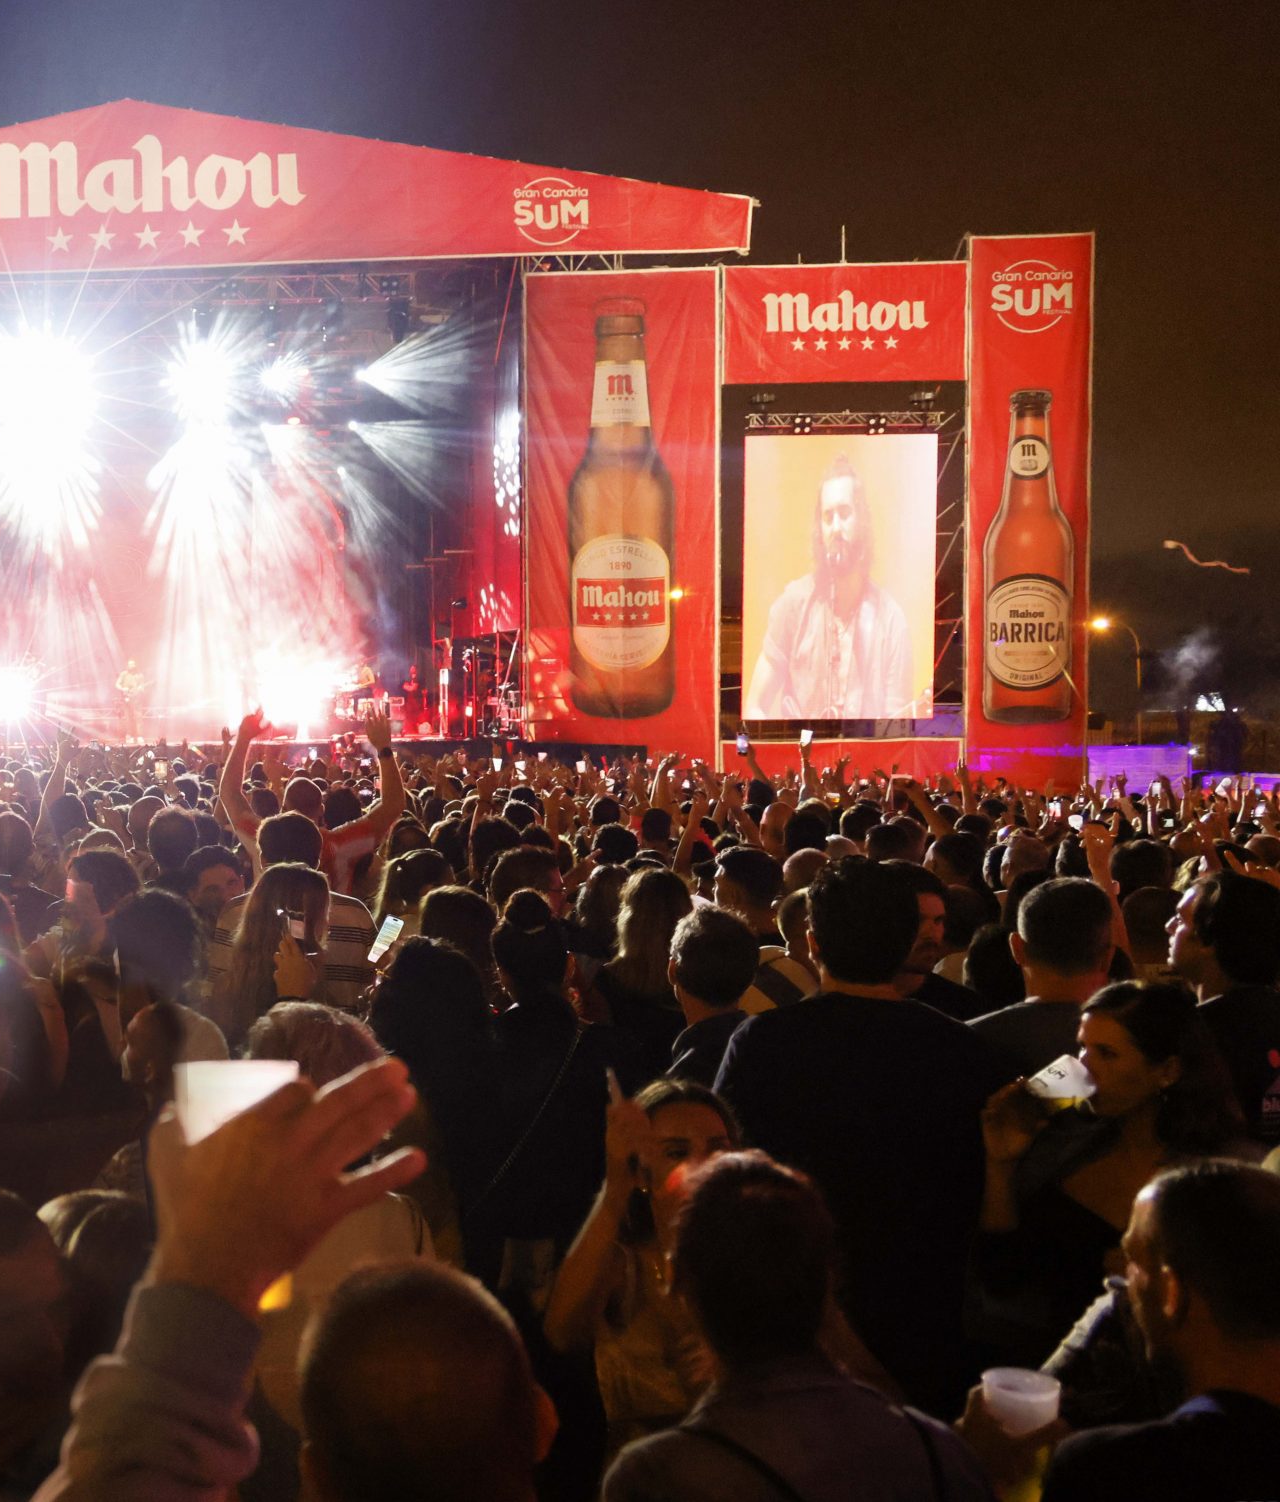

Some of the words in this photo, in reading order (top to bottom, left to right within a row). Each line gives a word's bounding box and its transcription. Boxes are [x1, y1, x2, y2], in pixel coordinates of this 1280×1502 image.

[513, 188, 540, 198] Gran
[542, 186, 589, 198] Canaria
[513, 199, 589, 230] SUM
[991, 271, 1022, 282] Gran
[1024, 270, 1073, 281] Canaria
[991, 282, 1073, 317] SUM
[761, 289, 930, 333] Mahou
[582, 585, 660, 608] Mahou
[1009, 609, 1045, 619] Mahou
[989, 622, 1065, 643] BARRICA
